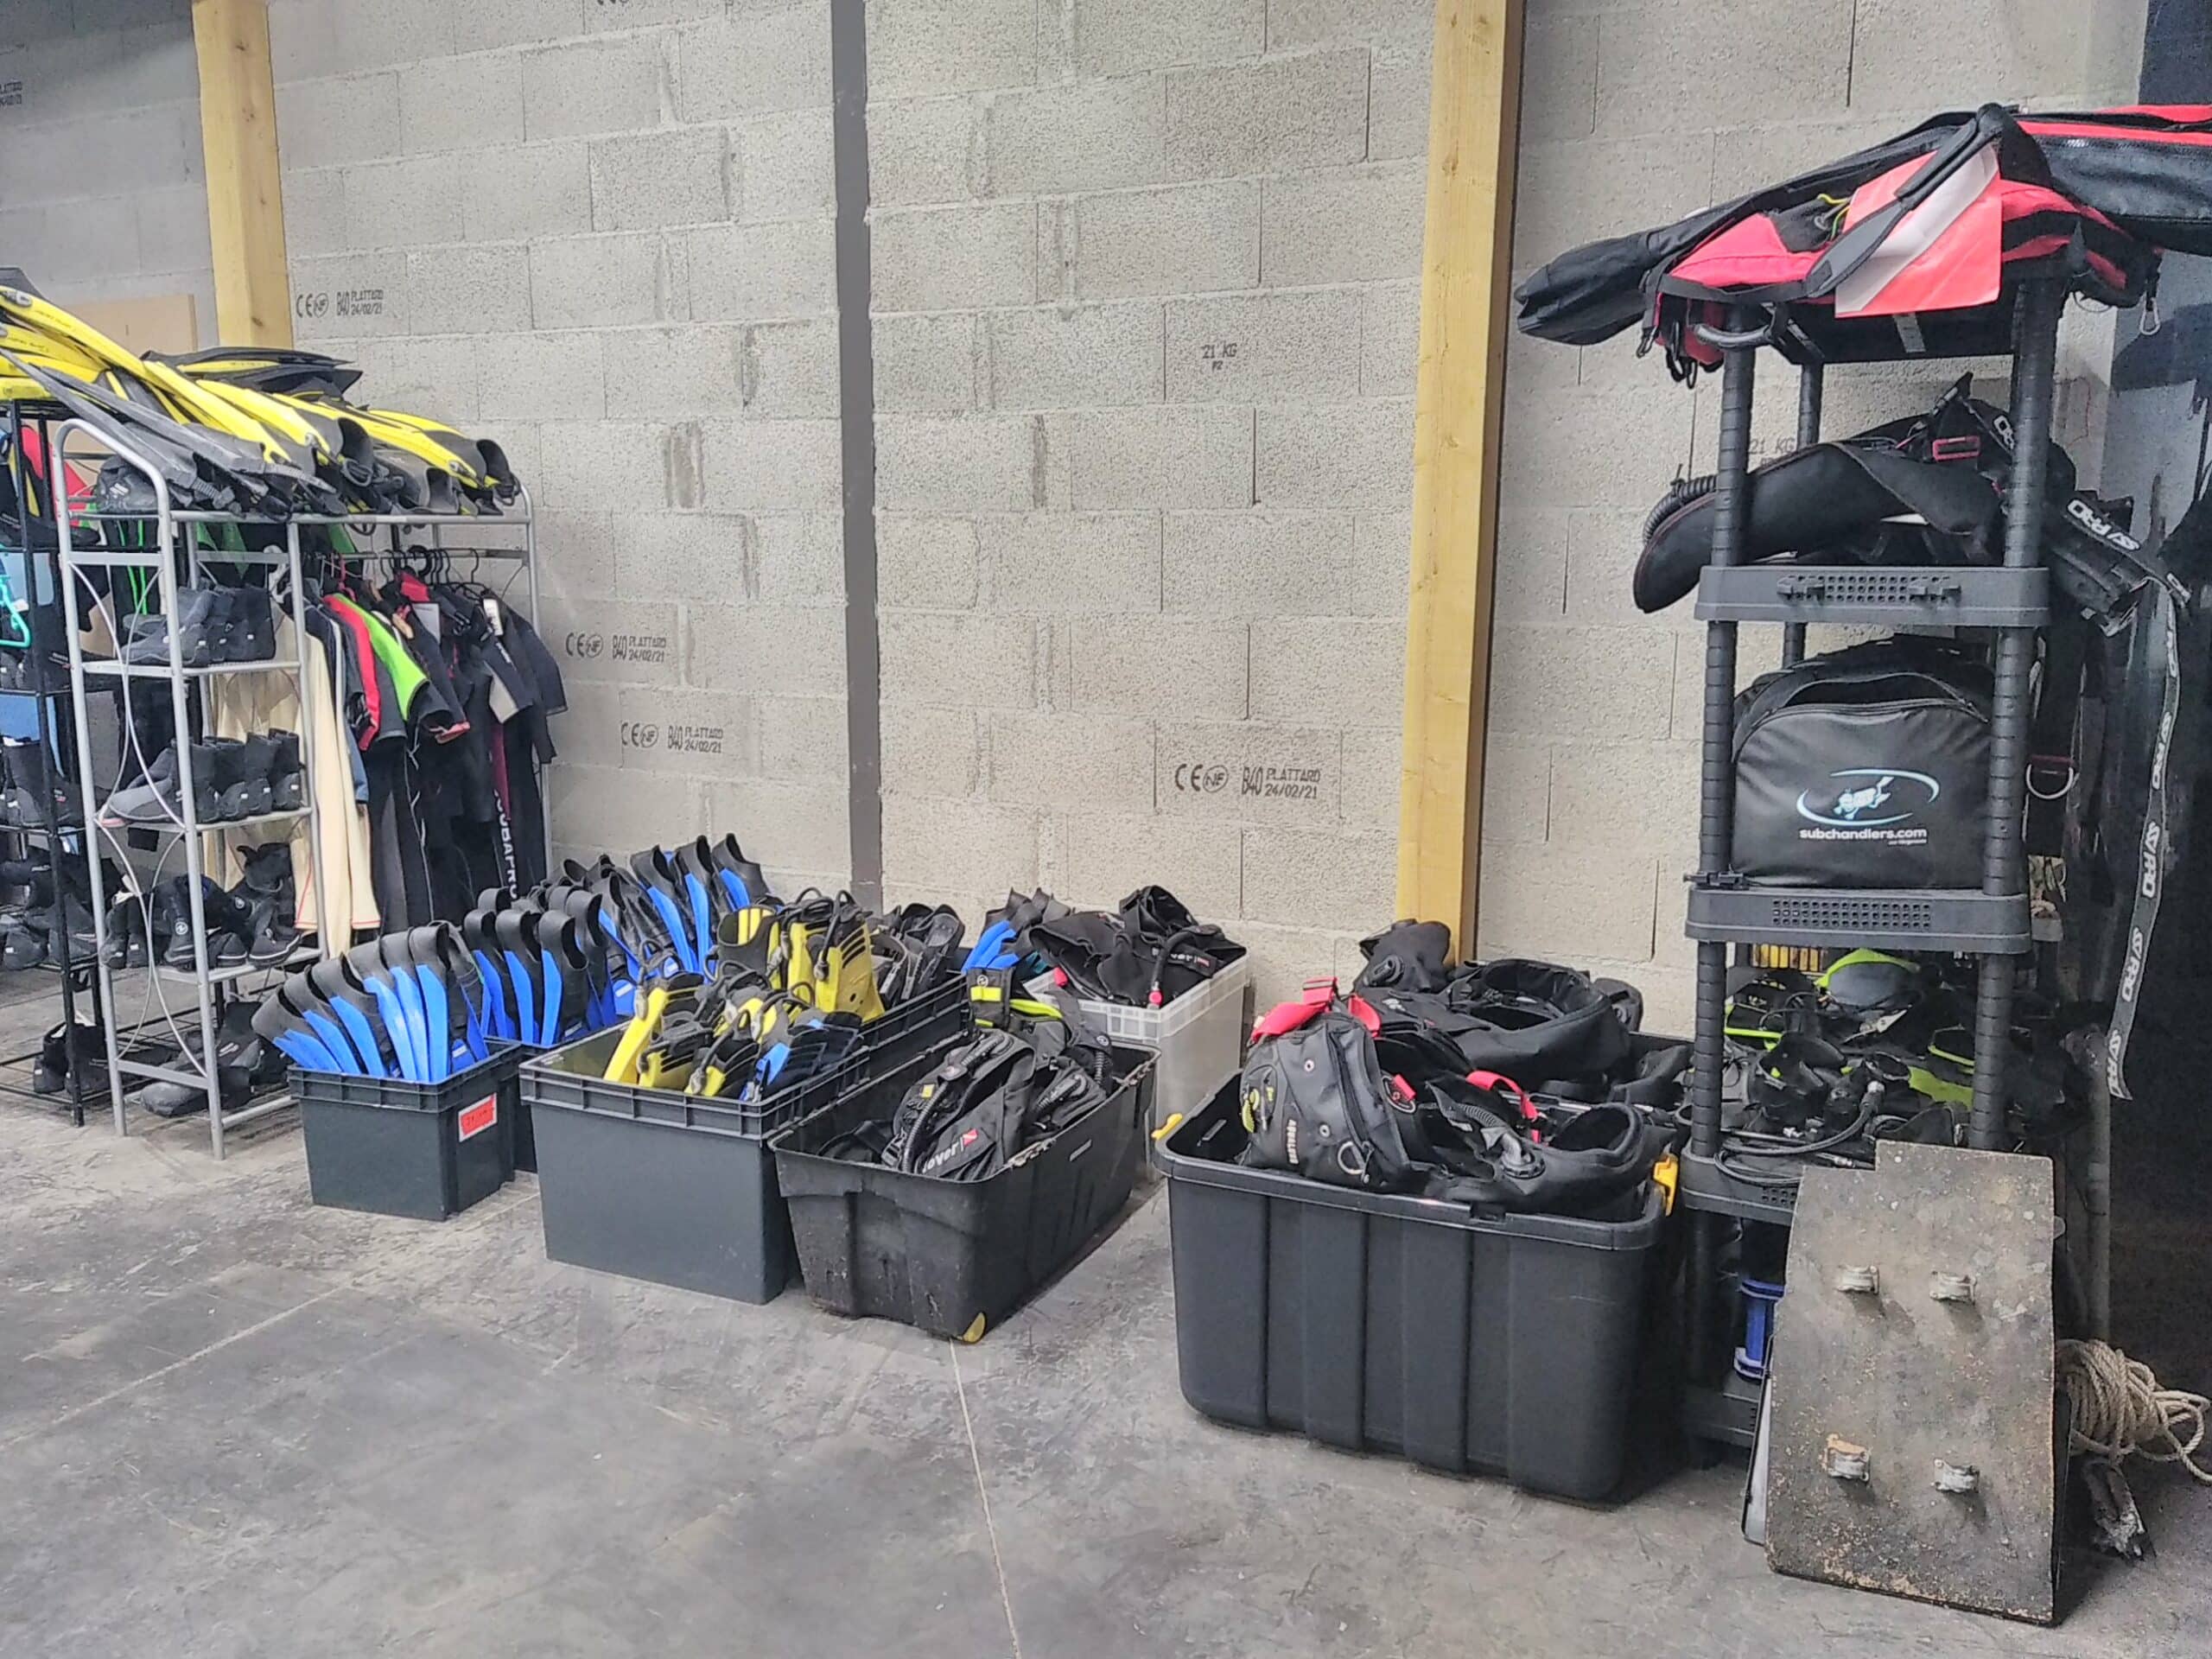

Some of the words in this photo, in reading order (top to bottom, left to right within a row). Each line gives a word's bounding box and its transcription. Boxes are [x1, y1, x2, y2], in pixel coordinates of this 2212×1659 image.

[1202, 345, 1215, 359] 21
[1223, 340, 1237, 358] KG
[1749, 437, 1764, 454] 21
[1775, 436, 1796, 454] KG
[2067, 499, 2112, 535] PRO
[1175, 764, 1204, 791] CE
[1266, 768, 1321, 783] PLATTARD
[1265, 783, 1318, 799] 24/02/21
[493, 788, 518, 899] UBAPRO
[1799, 827, 1928, 839] subchandlers.com
[2143, 851, 2157, 898] PRO
[2121, 956, 2140, 1002] PRO
